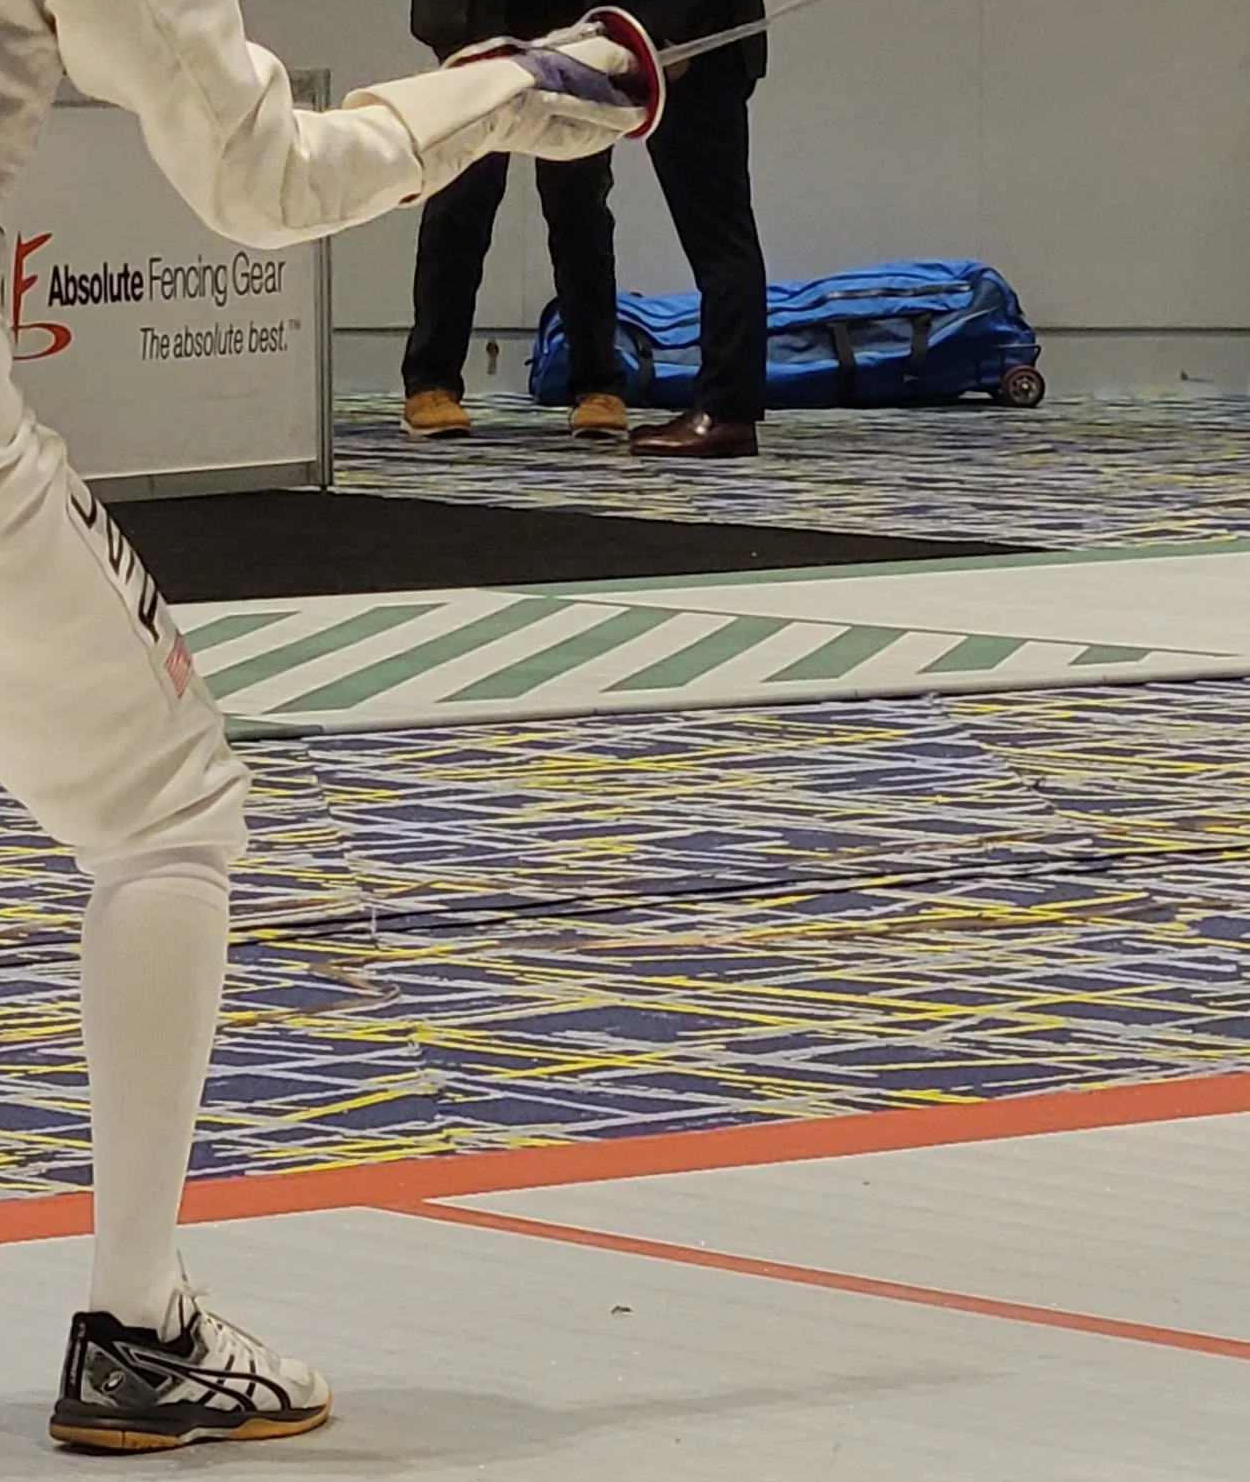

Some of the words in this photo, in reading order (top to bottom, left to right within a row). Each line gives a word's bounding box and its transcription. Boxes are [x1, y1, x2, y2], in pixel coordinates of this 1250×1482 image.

[48, 262, 144, 307] Absolute
[149, 254, 227, 307] Fencing
[233, 251, 286, 296] Gear
[140, 327, 170, 360] The
[173, 322, 243, 359] absolute
